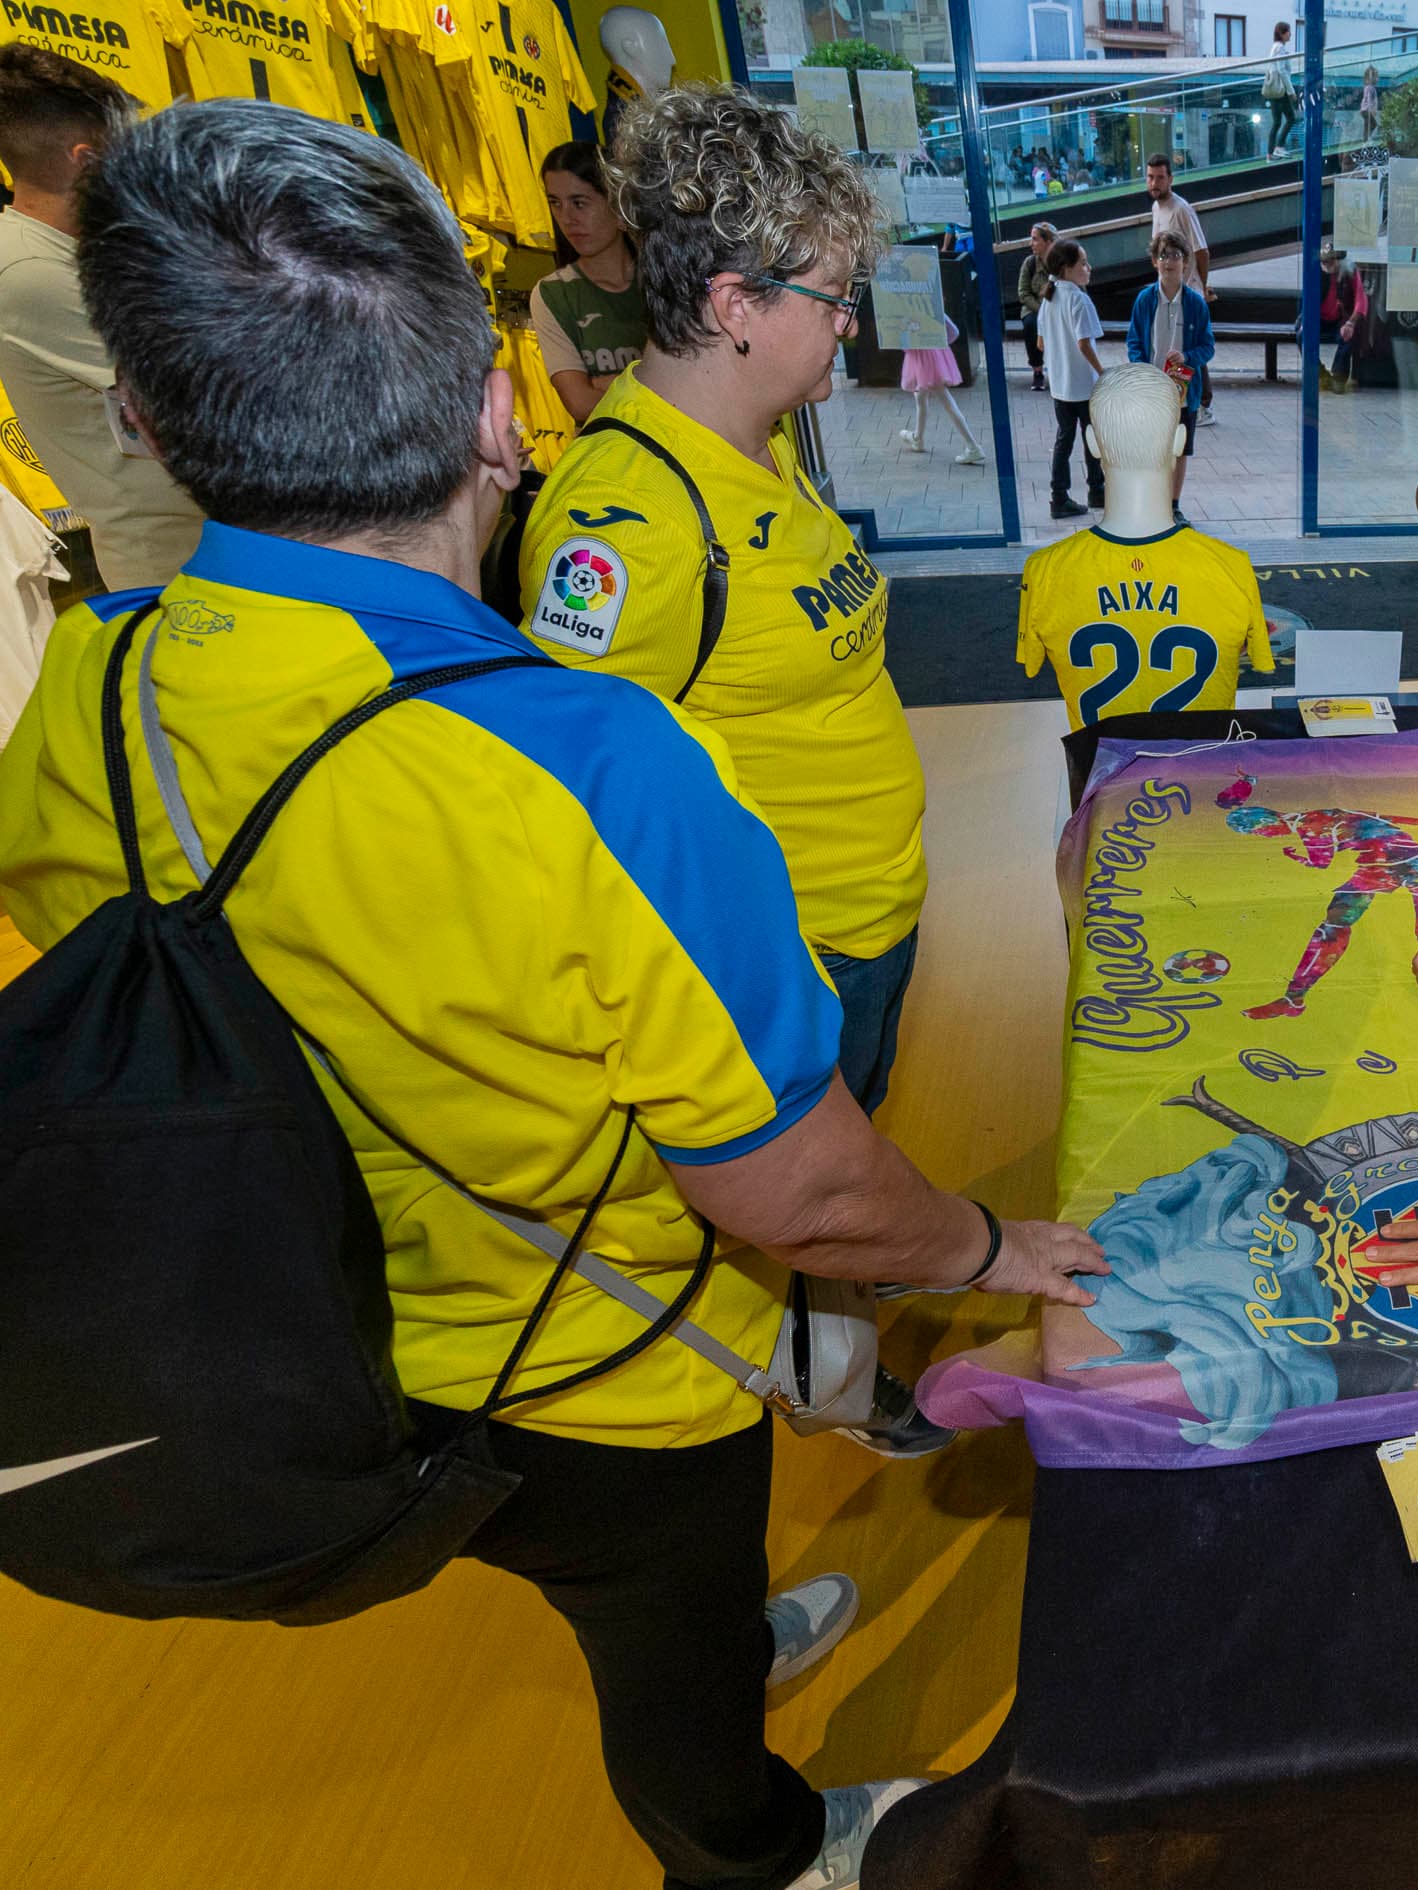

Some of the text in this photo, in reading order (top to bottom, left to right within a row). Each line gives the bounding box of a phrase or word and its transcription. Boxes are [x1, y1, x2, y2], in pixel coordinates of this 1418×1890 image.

[541, 606, 605, 641] LaLiga
[1097, 579, 1179, 617] AIXA
[1068, 621, 1219, 728] 22
[1243, 1187, 1342, 1347] Penya
